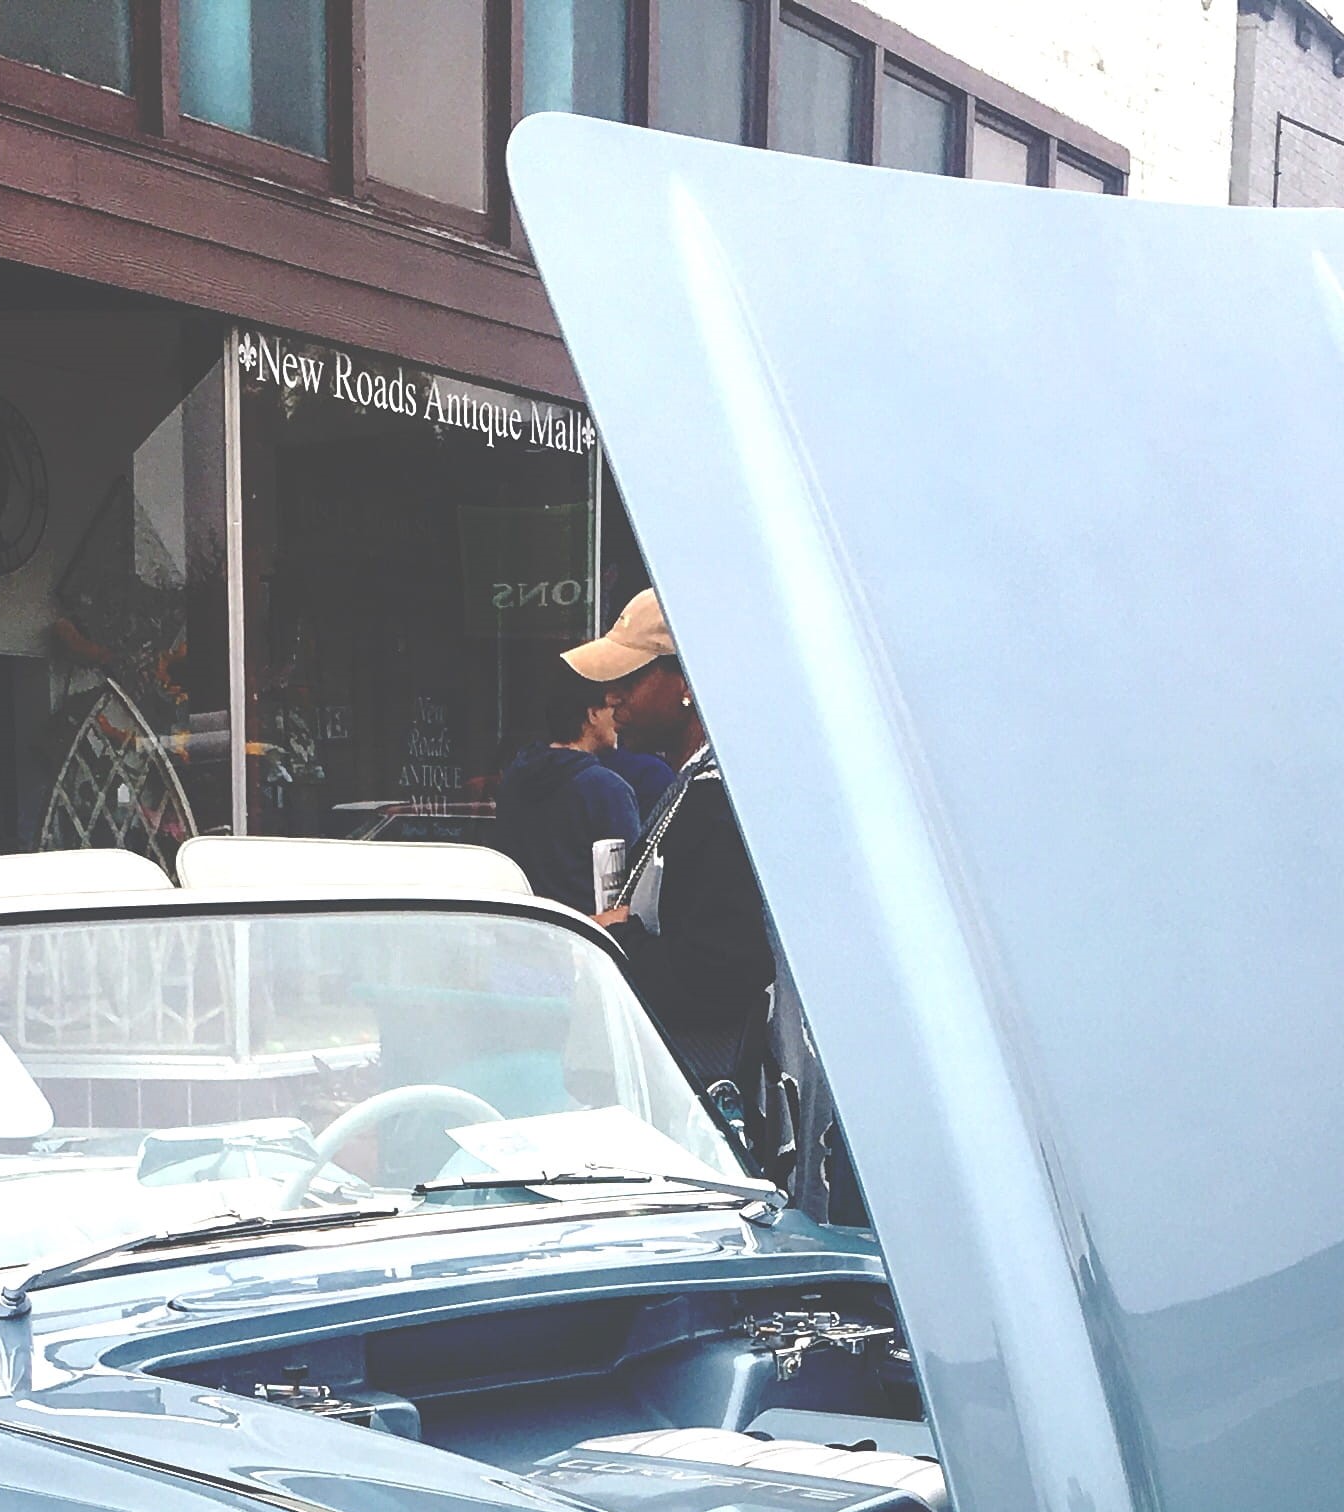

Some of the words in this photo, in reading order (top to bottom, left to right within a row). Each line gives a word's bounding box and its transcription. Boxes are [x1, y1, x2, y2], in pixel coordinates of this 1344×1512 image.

[256, 335, 325, 395] New
[333, 352, 417, 417] Roads
[423, 378, 523, 448] Antique
[529, 400, 584, 455] Mall
[399, 764, 464, 793] ANTIQUE
